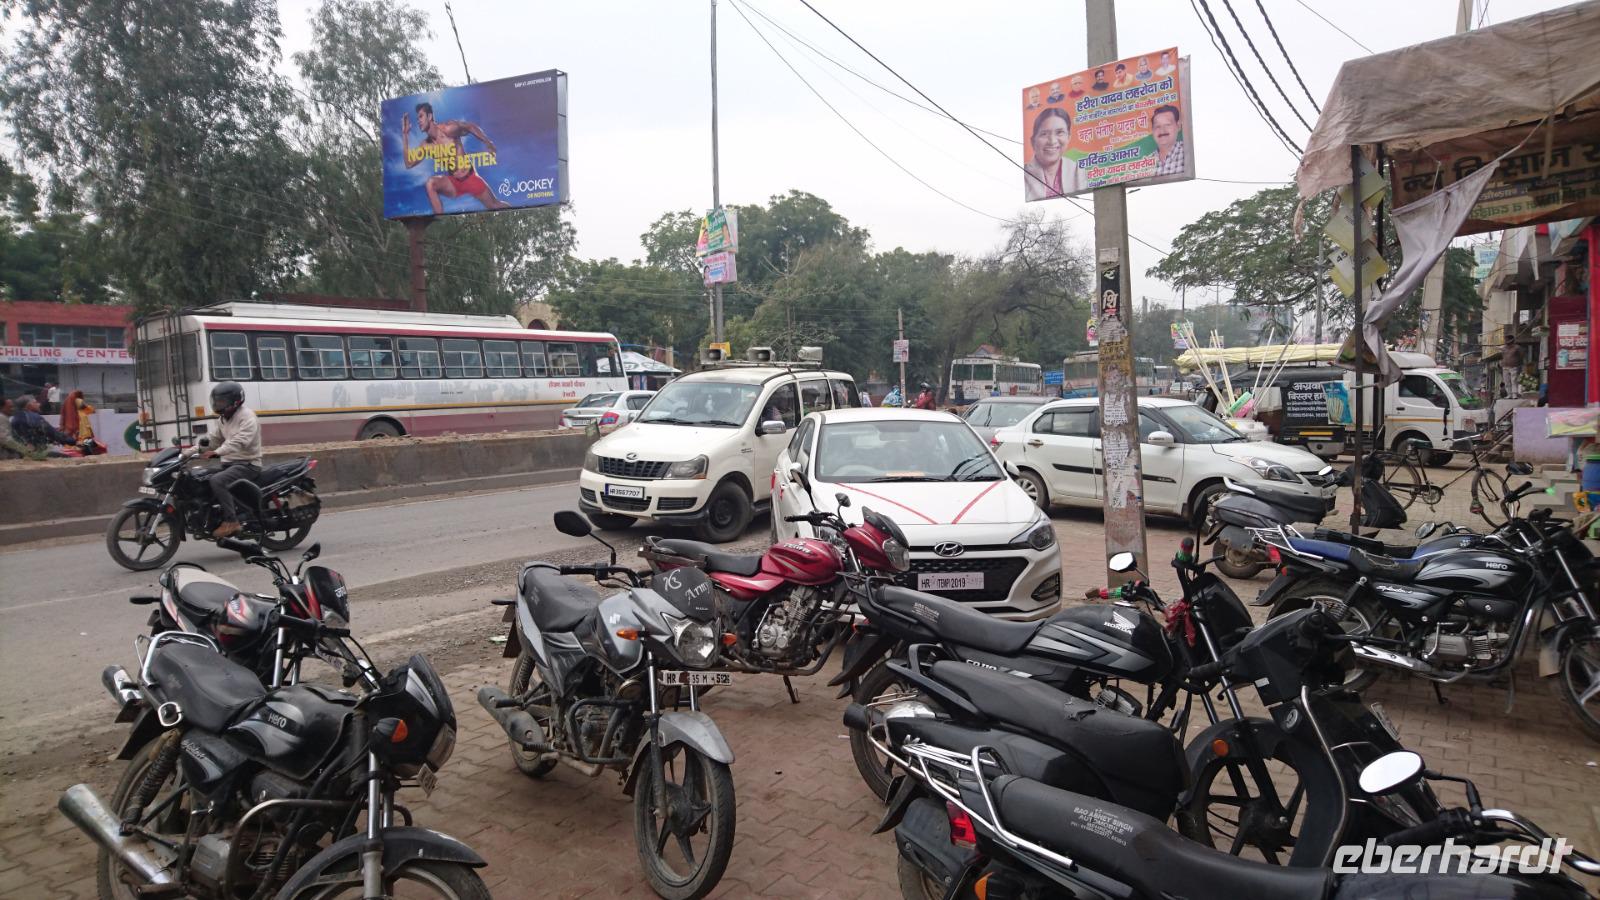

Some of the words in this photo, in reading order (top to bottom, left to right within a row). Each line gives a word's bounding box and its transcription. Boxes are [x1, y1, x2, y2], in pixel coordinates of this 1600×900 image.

[1076, 96, 1098, 112] हरीश
[1100, 91, 1123, 105] यादव
[1125, 82, 1157, 100] लहरोदा
[1159, 77, 1173, 91] को
[1117, 119, 1136, 131] यादव
[408, 143, 456, 162] NOTHING
[1078, 153, 1107, 169] हार्दिक
[1110, 147, 1139, 162] आभार
[434, 156, 456, 172] FITS
[457, 152, 497, 169] BETTER
[1107, 163, 1126, 175] यादव
[512, 178, 554, 193] JOCKEY
[76, 349, 129, 358] CENTE
[1293, 382, 1321, 391] अग्रवा
[1288, 391, 1312, 400] बिस्तर
[1485, 562, 1508, 570] Hero
[921, 578, 931, 588] HR
[951, 577, 966, 588] 2019
[1103, 621, 1133, 635] HONDA
[666, 673, 677, 684] HR
[268, 712, 287, 728] Hero
[1078, 814, 1125, 835] AUTOMOBILE
[1112, 819, 1134, 833] SINGH
